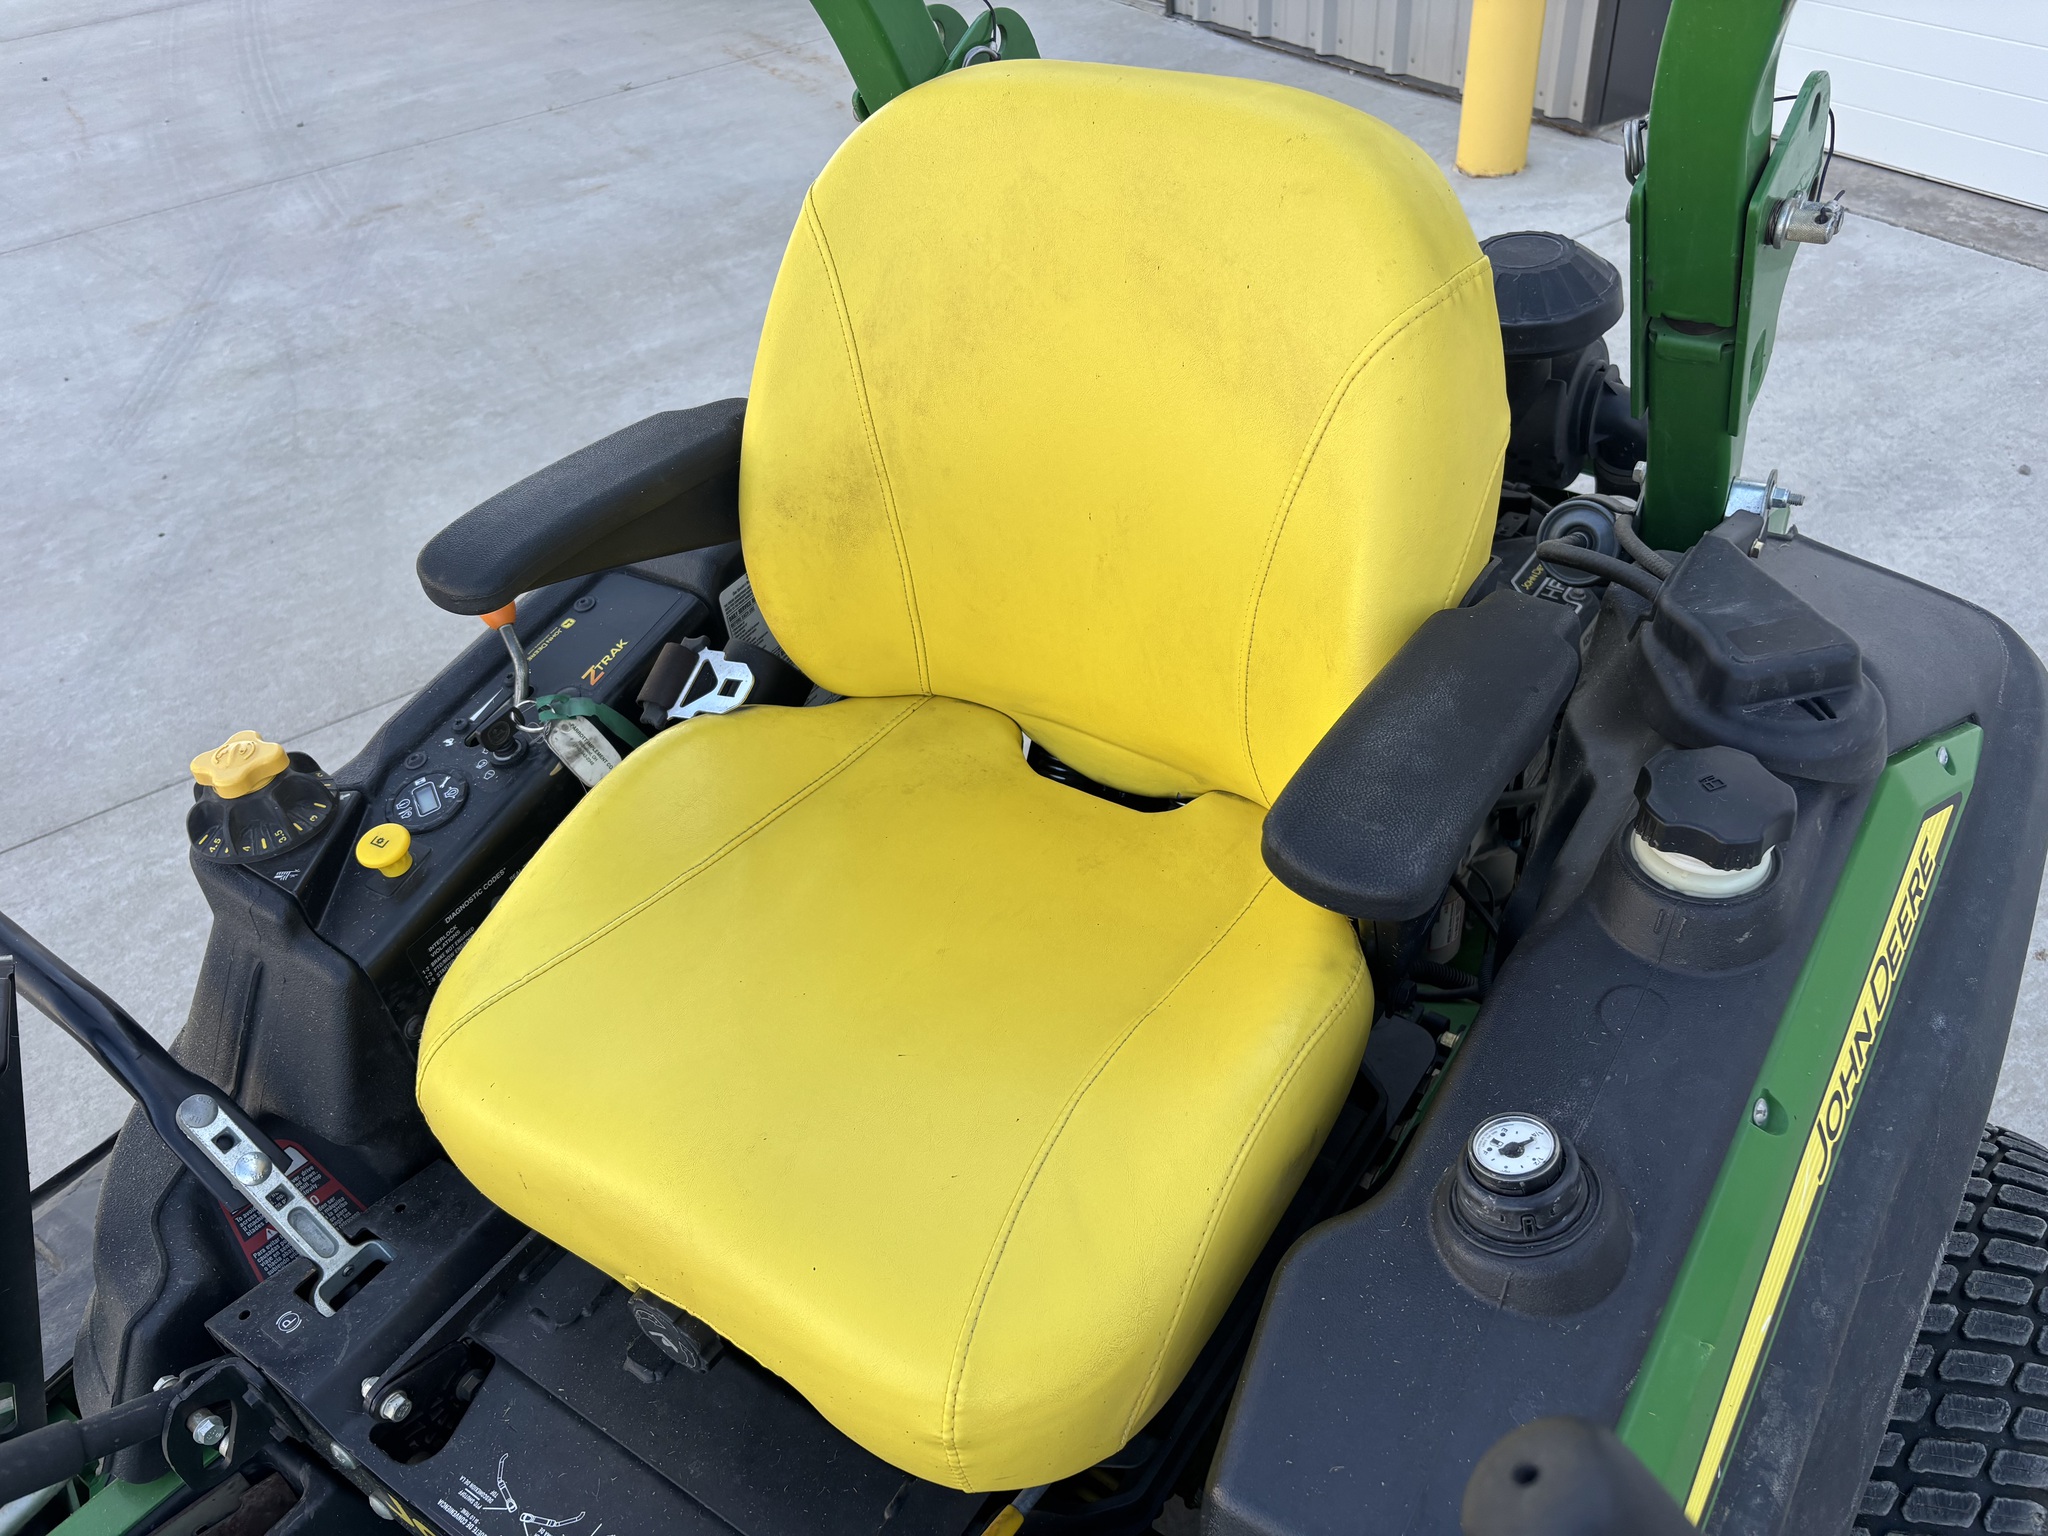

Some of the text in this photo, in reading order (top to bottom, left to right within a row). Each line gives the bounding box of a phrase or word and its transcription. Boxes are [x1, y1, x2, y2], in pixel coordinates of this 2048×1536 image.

[547, 628, 562, 643] JOHN
[527, 643, 548, 661] DEERE
[309, 814, 318, 822] 3
[274, 829, 287, 844] 3.5
[209, 837, 222, 853] 4.5
[444, 888, 482, 923] DIAGNOSTIC
[428, 924, 457, 952] INTERLOCK
[430, 929, 460, 957] VIOLATIONS
[430, 952, 445, 967] BRAKE
[445, 943, 454, 954] NOT
[454, 926, 474, 945] ENGAGED
[1818, 835, 1935, 1181] JOHN DEERE
[301, 1165, 314, 1176] drive
[301, 1170, 318, 1182] down.
[310, 1173, 321, 1183] stop
[302, 1183, 317, 1195] lowly.
[333, 1200, 348, 1213] arriba
[335, 1207, 347, 1218] para
[239, 1213, 257, 1227] across
[245, 1222, 263, 1236] blades
[252, 1237, 280, 1258] Para evitar
[256, 1244, 280, 1262] causadas
[259, 1256, 273, 1267] viaje
[267, 1256, 282, 1268] hacia
[437, 1498, 486, 1536] UETE DE CONVENIENCIA
